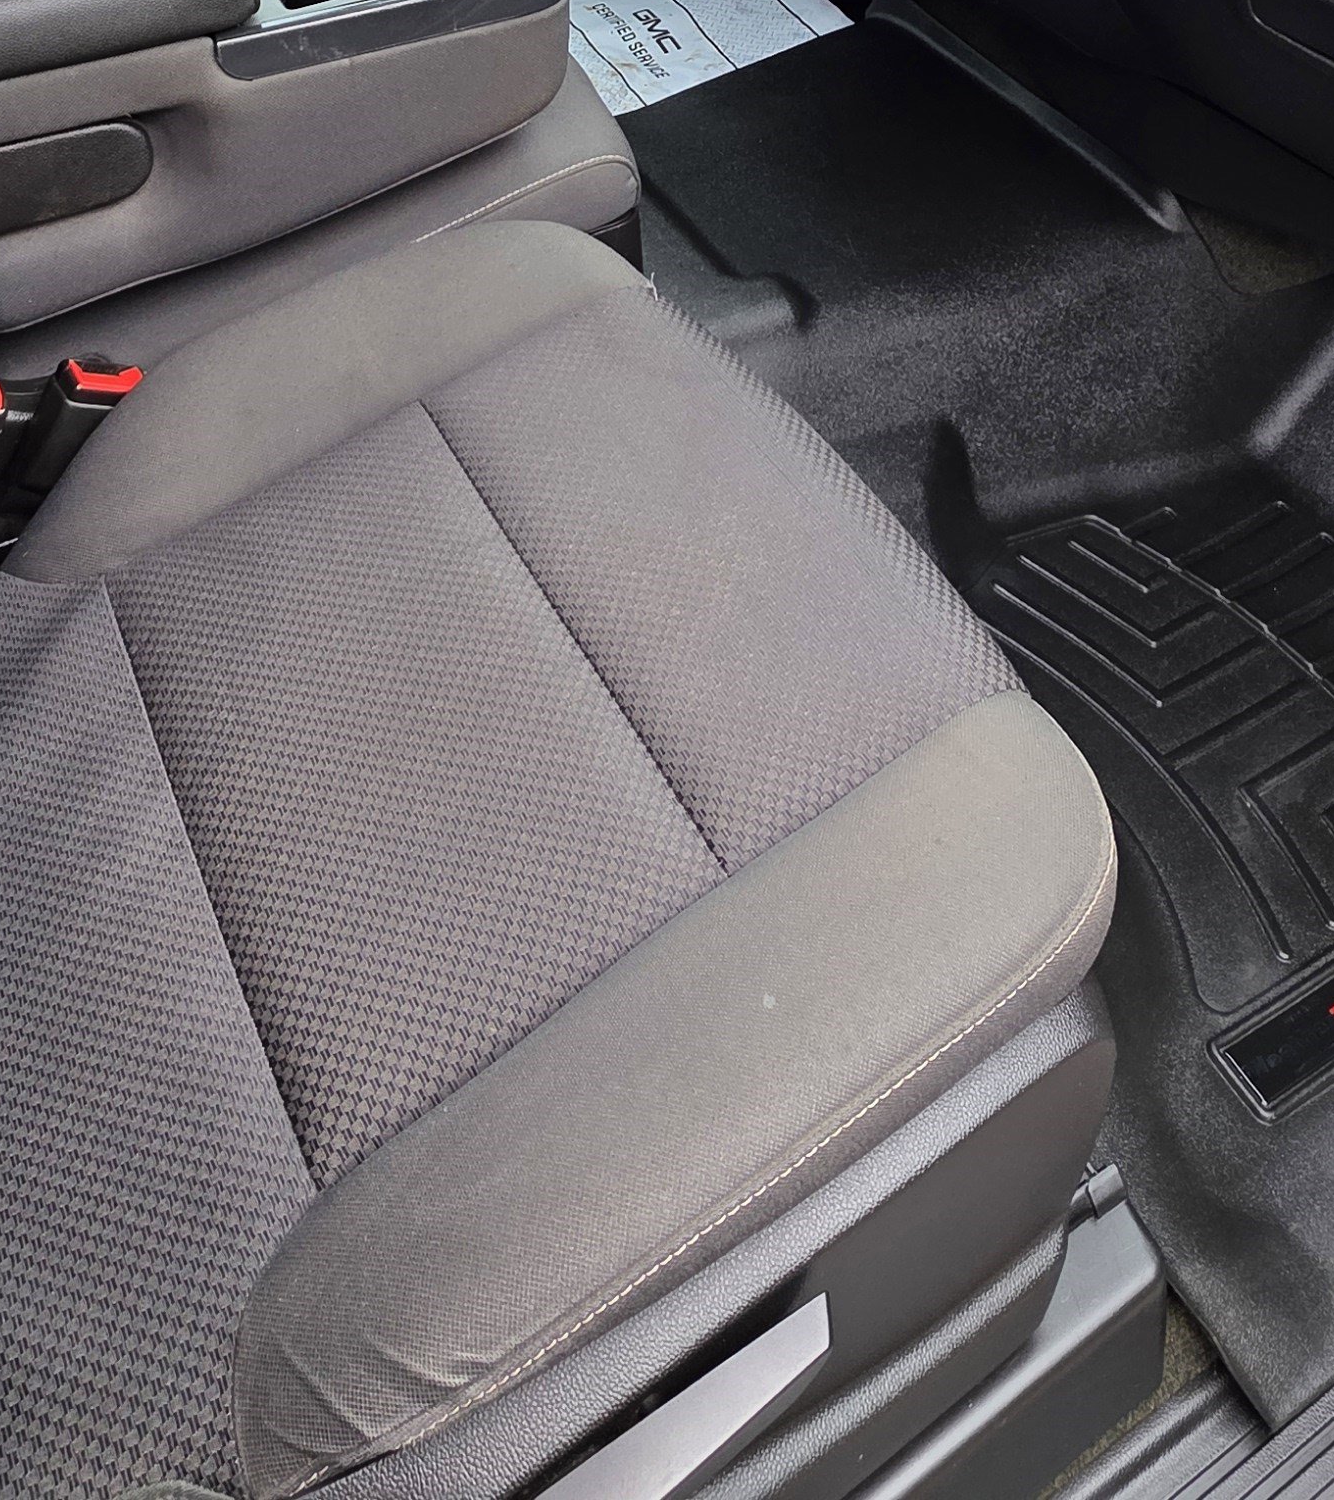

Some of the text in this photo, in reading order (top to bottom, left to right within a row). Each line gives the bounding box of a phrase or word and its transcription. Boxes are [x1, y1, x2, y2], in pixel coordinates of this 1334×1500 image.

[591, 2, 670, 79] CERTIFIED SERVICE
[632, 7, 682, 54] GMC
